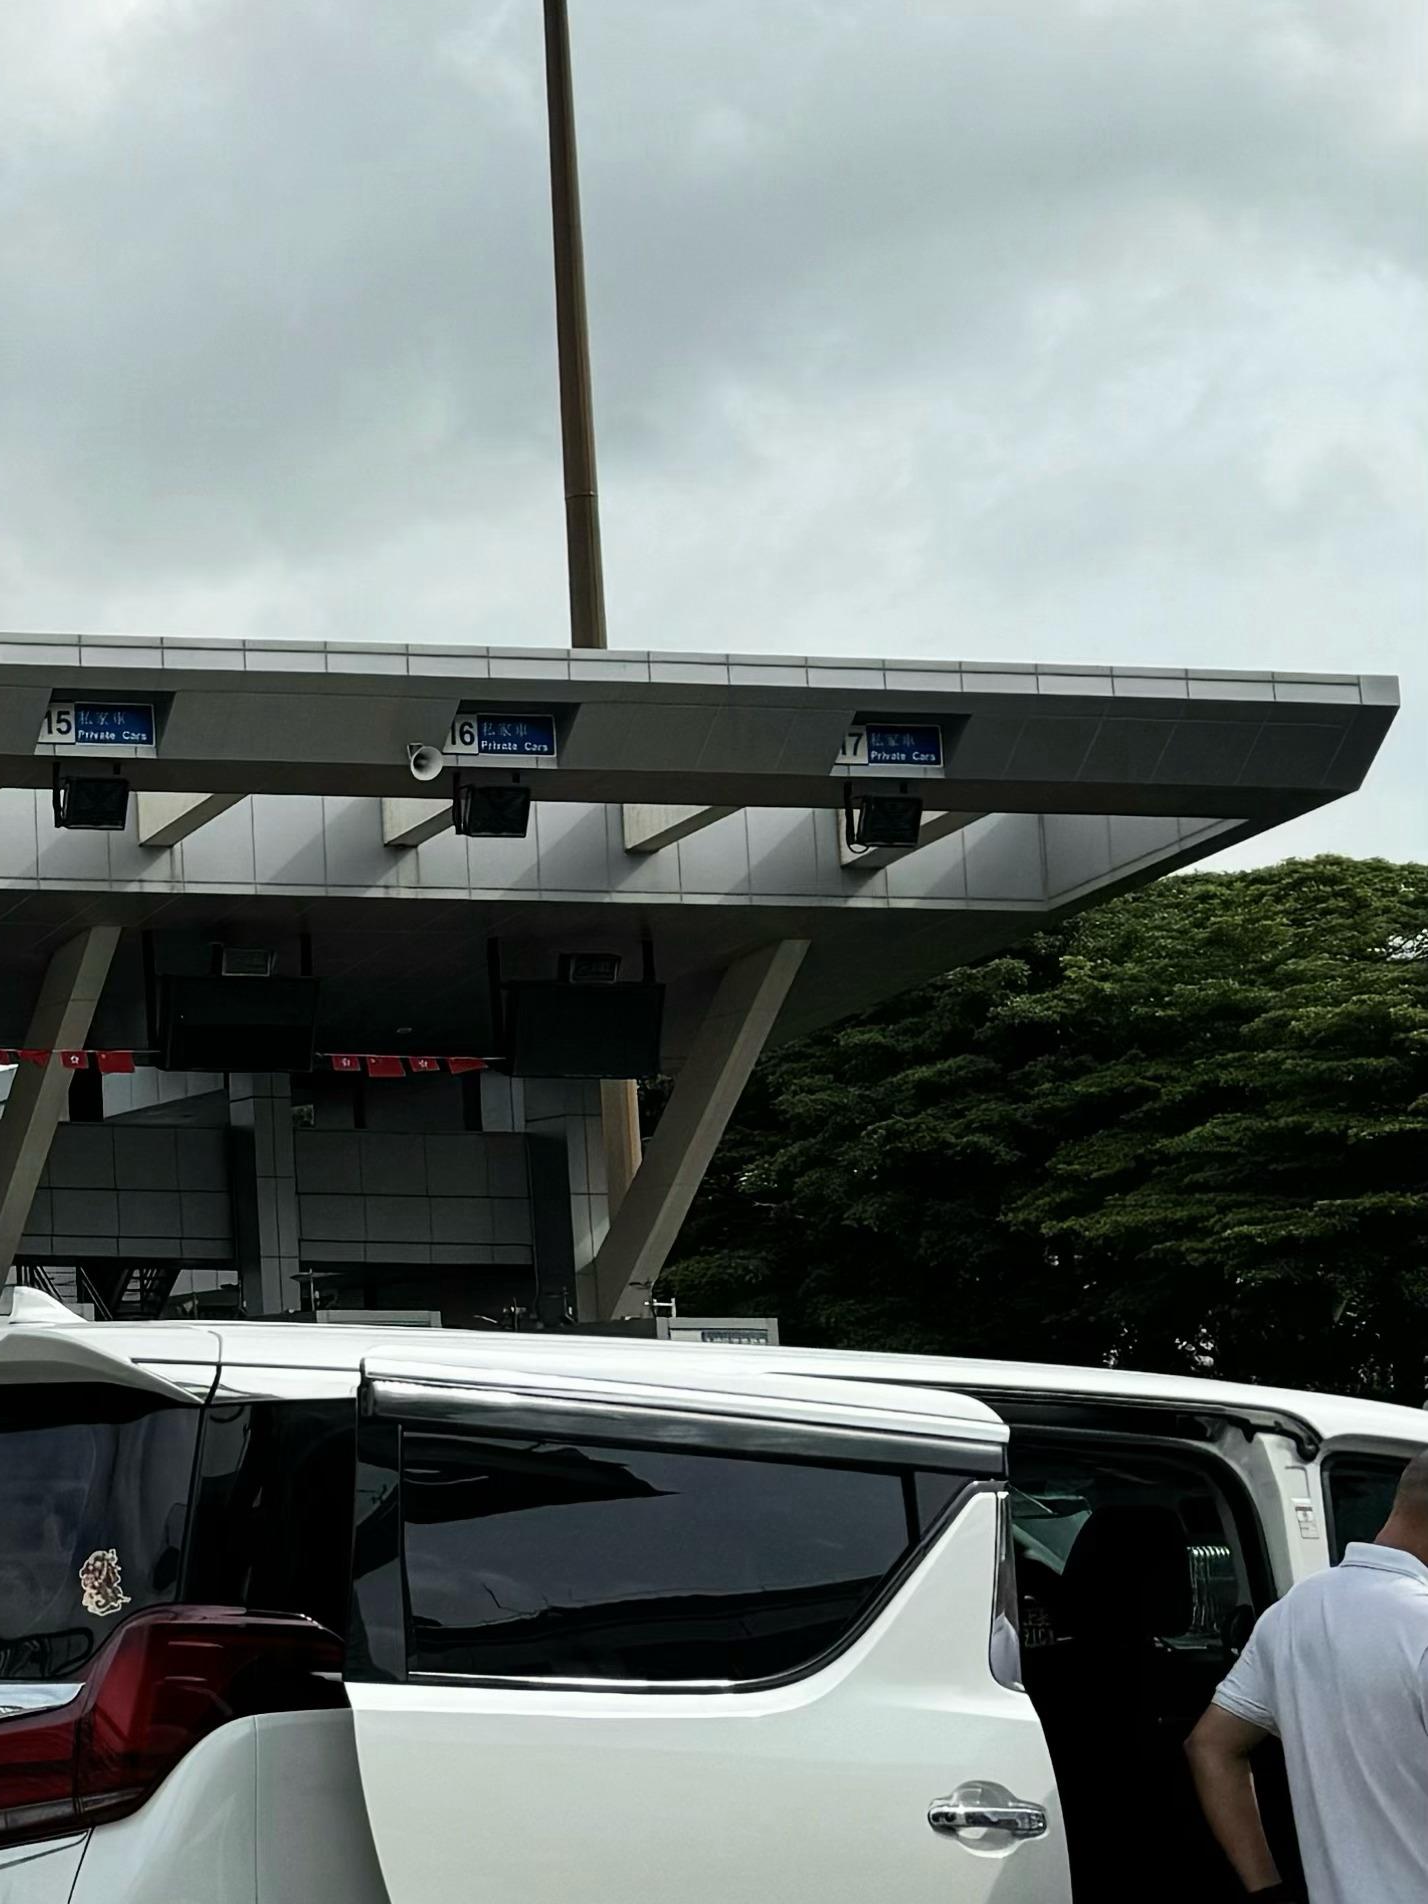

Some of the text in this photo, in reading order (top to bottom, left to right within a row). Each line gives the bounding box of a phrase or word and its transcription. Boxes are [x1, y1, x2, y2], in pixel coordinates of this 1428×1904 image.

[45, 710, 72, 735] 15
[77, 730, 147, 741] Private Cars
[450, 721, 475, 746] 16
[481, 740, 548, 752] Private Cars
[870, 750, 935, 761] Private Cars
